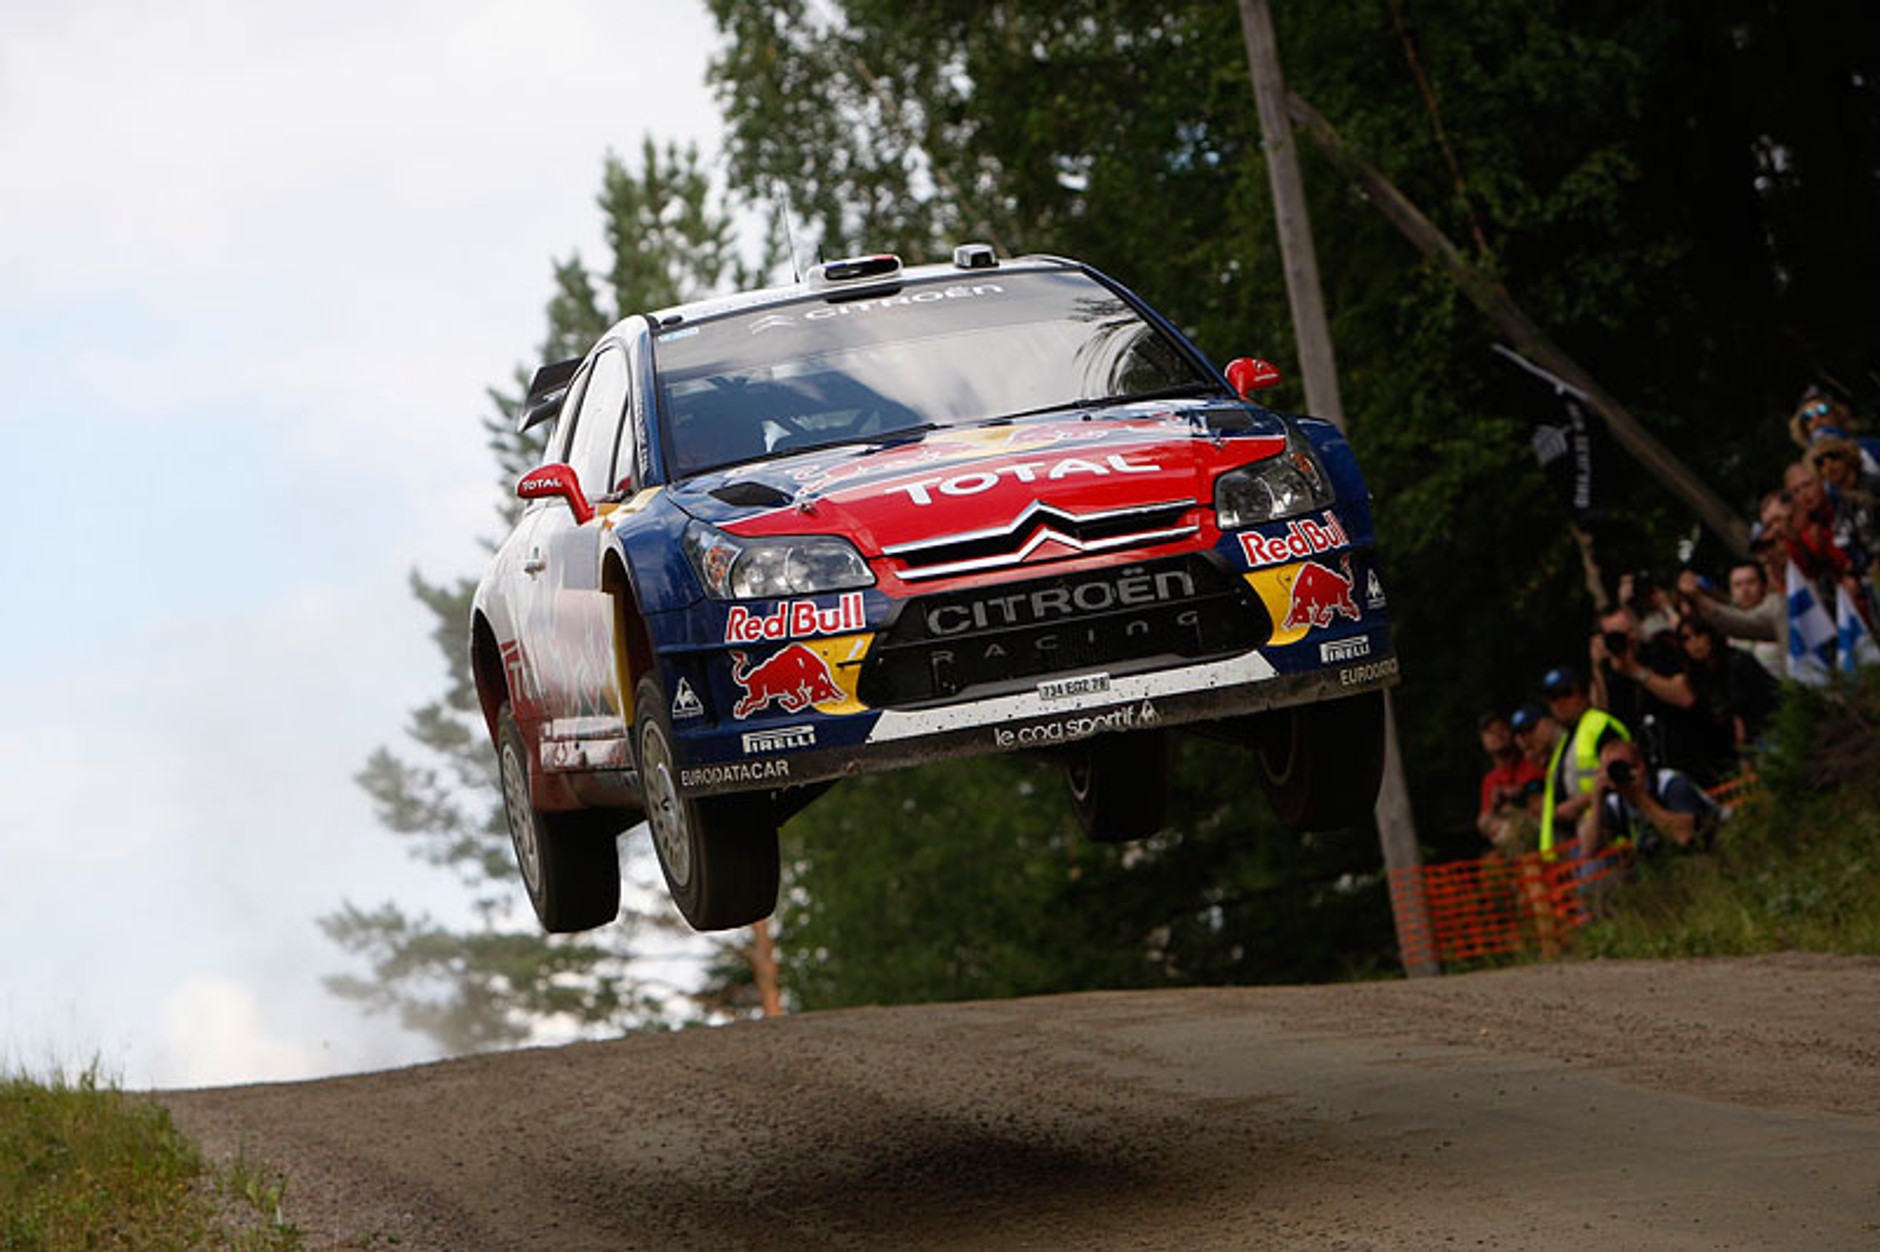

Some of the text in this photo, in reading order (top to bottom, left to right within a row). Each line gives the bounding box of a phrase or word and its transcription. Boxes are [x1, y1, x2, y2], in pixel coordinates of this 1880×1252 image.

[522, 479, 563, 491] TOTAL
[884, 454, 1161, 506] TOTAL
[1237, 510, 1349, 567] Red Bull
[724, 592, 866, 643] Red Bull
[927, 566, 1196, 635] CITROËN
[1319, 635, 1371, 664] PIRELLI
[742, 725, 816, 754] PIRELLI
[994, 704, 1134, 747] le coq sportif
[681, 759, 790, 787] EURODATACAR
